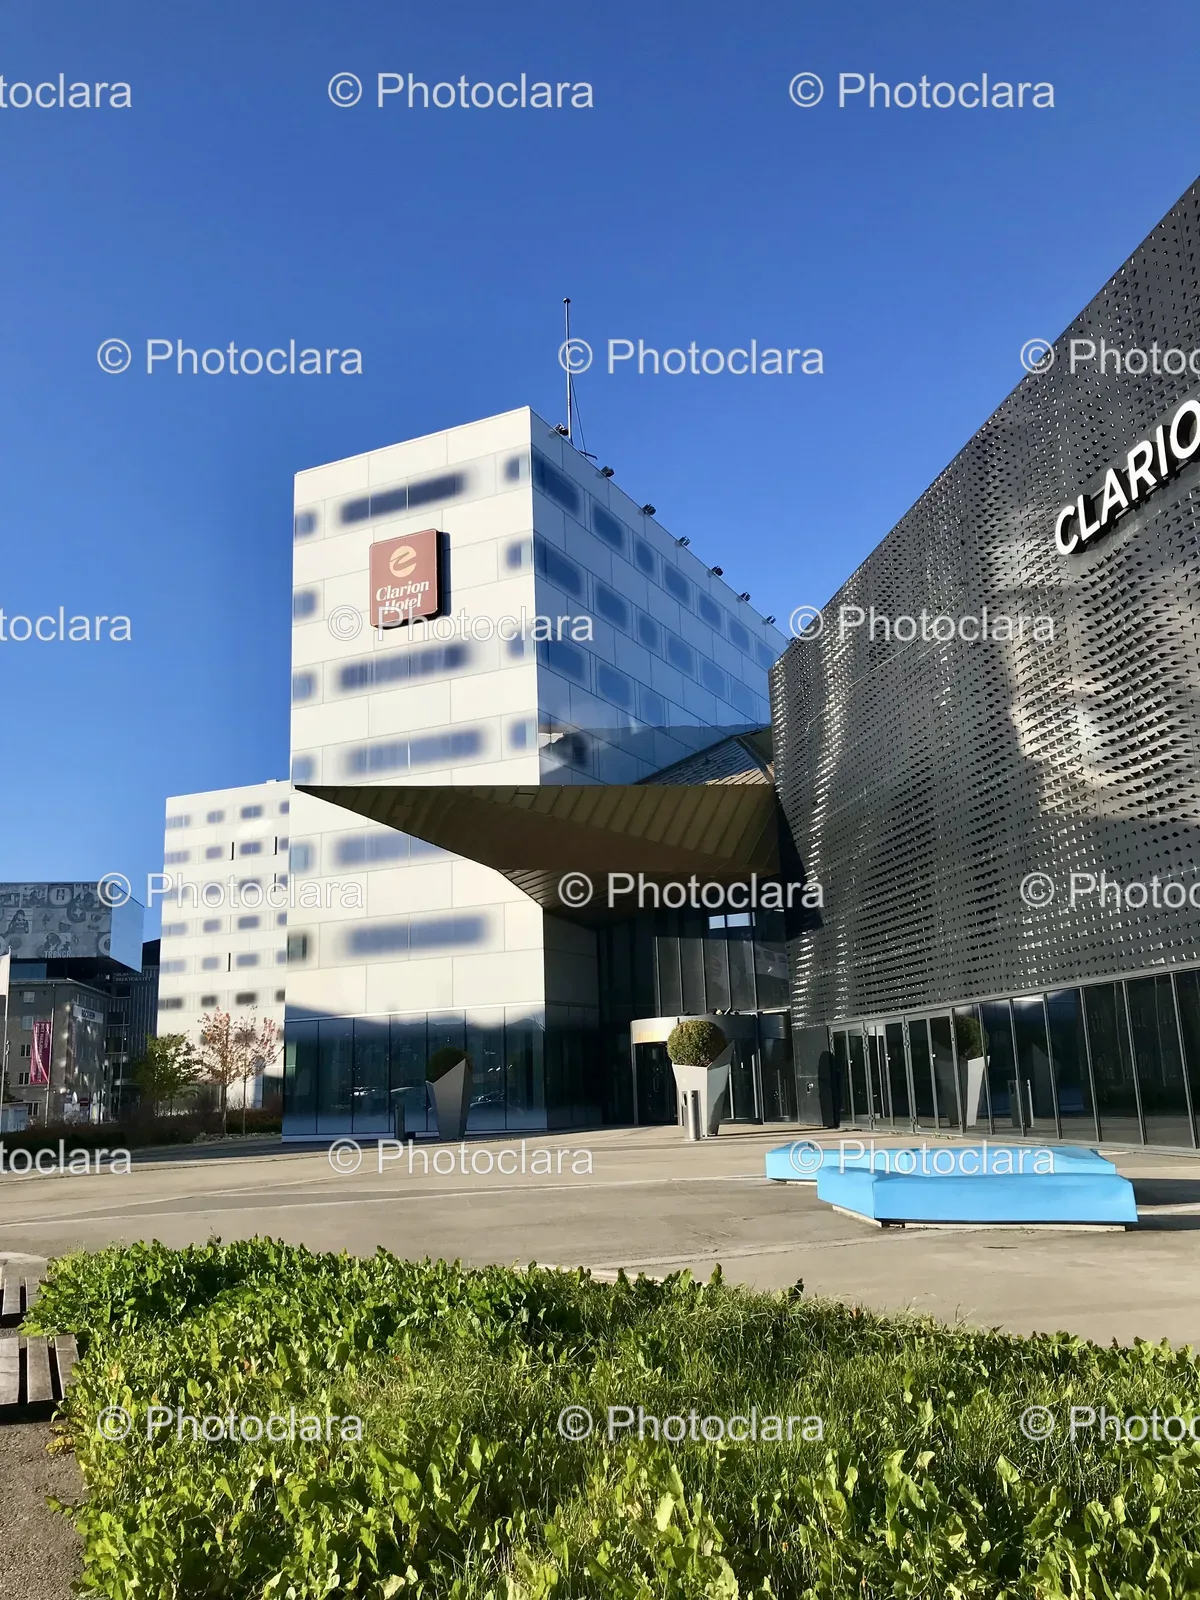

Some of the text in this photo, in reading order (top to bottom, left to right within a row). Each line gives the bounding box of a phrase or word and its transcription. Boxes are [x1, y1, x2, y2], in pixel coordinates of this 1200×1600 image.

[1055, 400, 1200, 555] CLARIO
[376, 581, 430, 602] Clarion
[384, 593, 422, 614] Hotel
